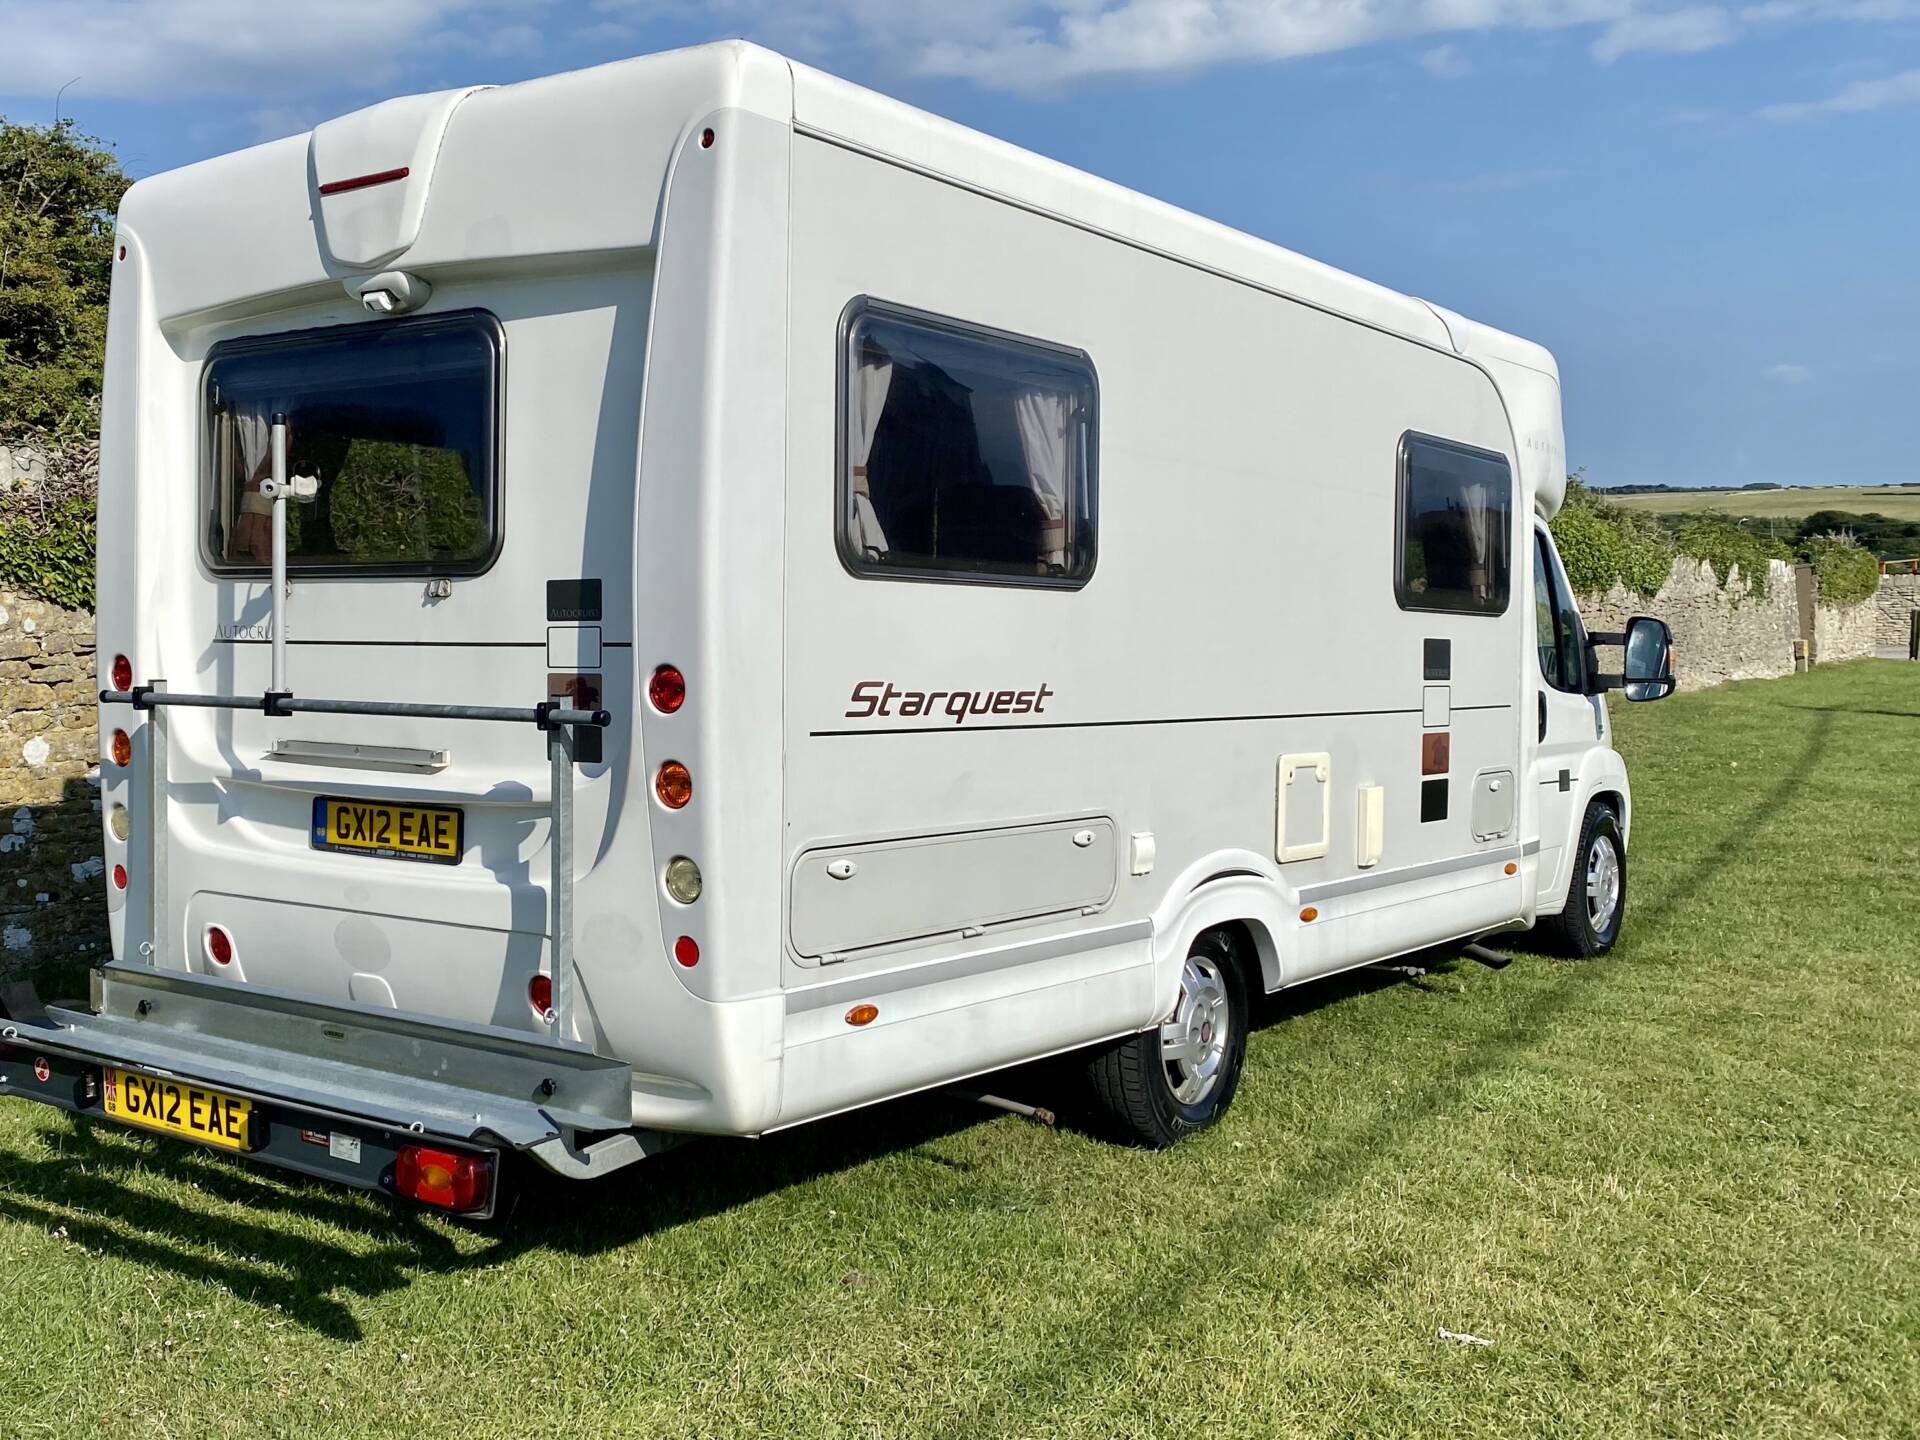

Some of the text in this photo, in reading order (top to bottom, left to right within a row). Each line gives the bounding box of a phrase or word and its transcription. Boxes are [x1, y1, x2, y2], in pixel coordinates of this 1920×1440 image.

[214, 622, 290, 640] AUTOCRUE
[845, 681, 1054, 724] Starquest
[336, 806, 450, 850] GX12 EAE
[125, 1075, 241, 1140] GX12 EAE
